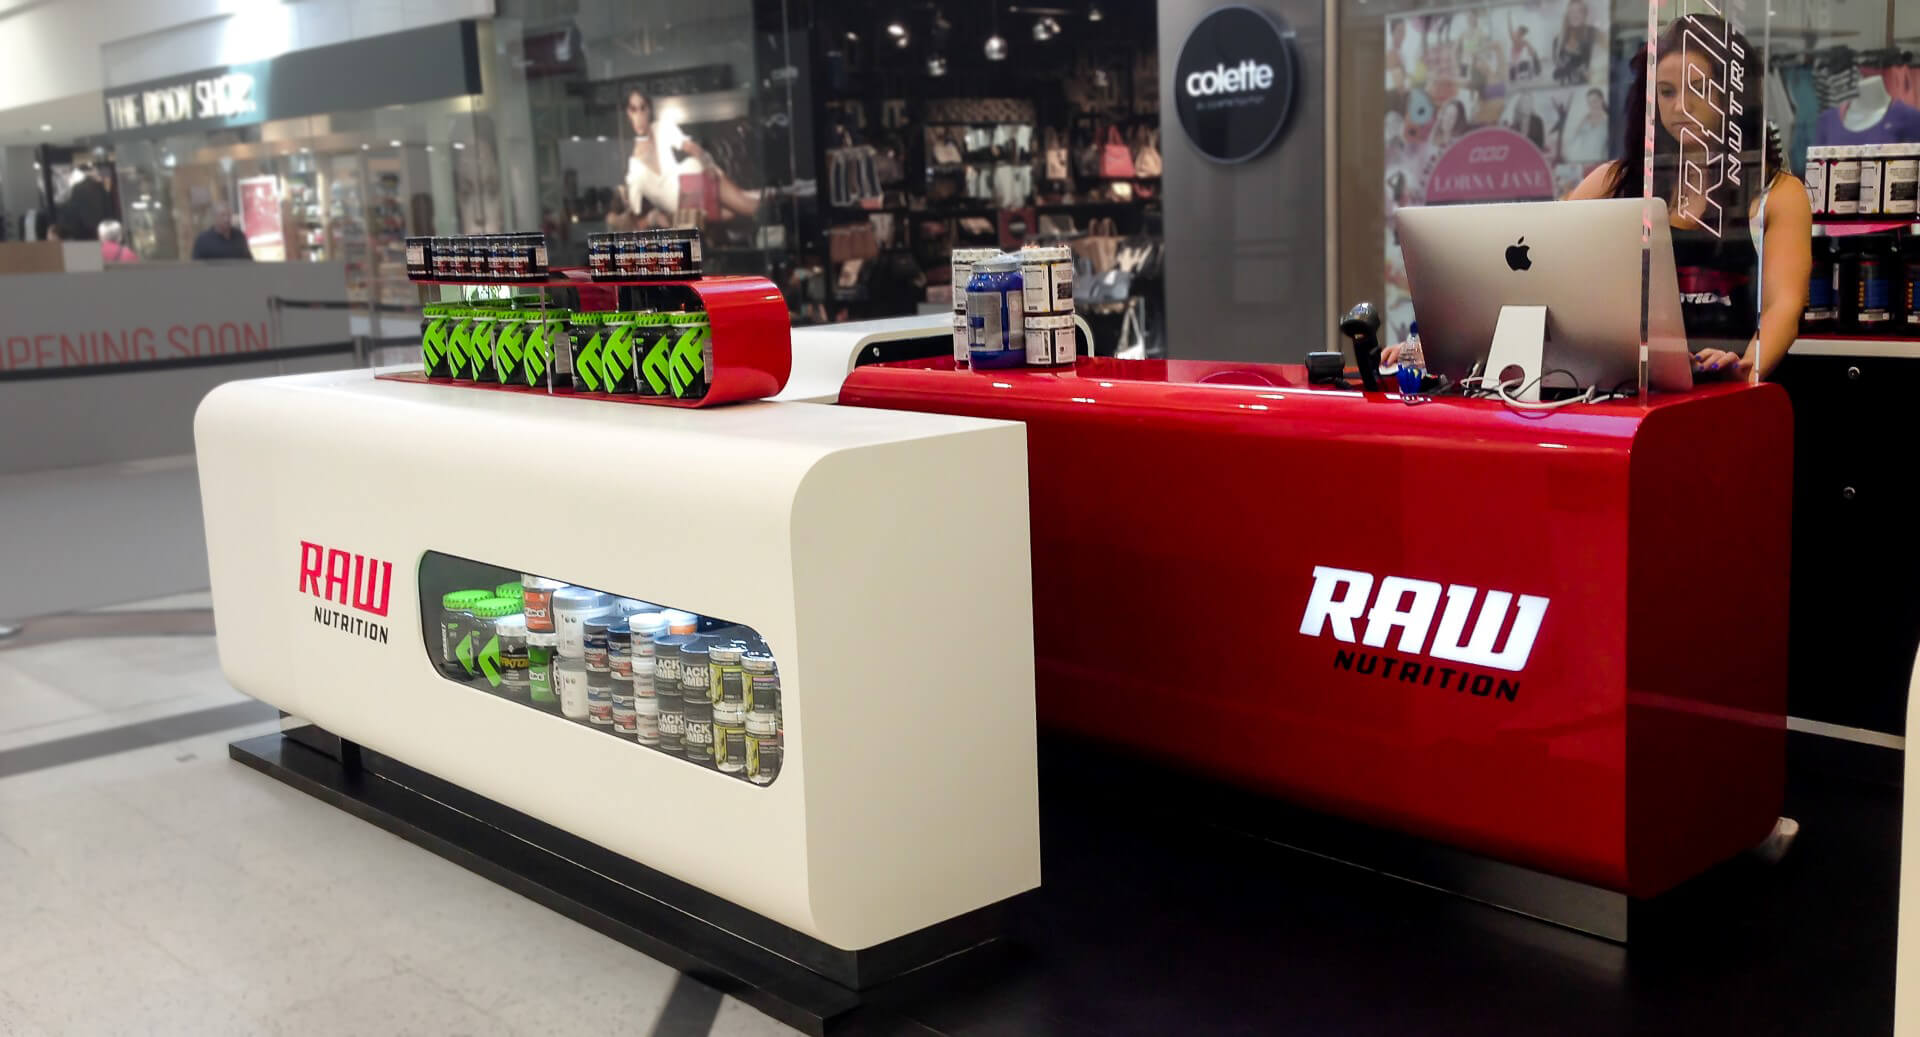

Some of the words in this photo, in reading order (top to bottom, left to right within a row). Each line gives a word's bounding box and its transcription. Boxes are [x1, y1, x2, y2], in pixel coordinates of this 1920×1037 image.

[107, 93, 143, 131] THE
[141, 83, 194, 126] BODY
[195, 72, 257, 119] SHOP
[1186, 58, 1274, 97] colette
[1434, 173, 1495, 193] LORNA
[1501, 168, 1546, 190] JANE
[0, 326, 158, 370] PENING
[166, 320, 270, 359] SOON
[299, 540, 393, 617] RAW
[314, 605, 389, 645] NUTRITION
[1299, 565, 1550, 672] RAW
[1333, 649, 1521, 703] NUTRITION
